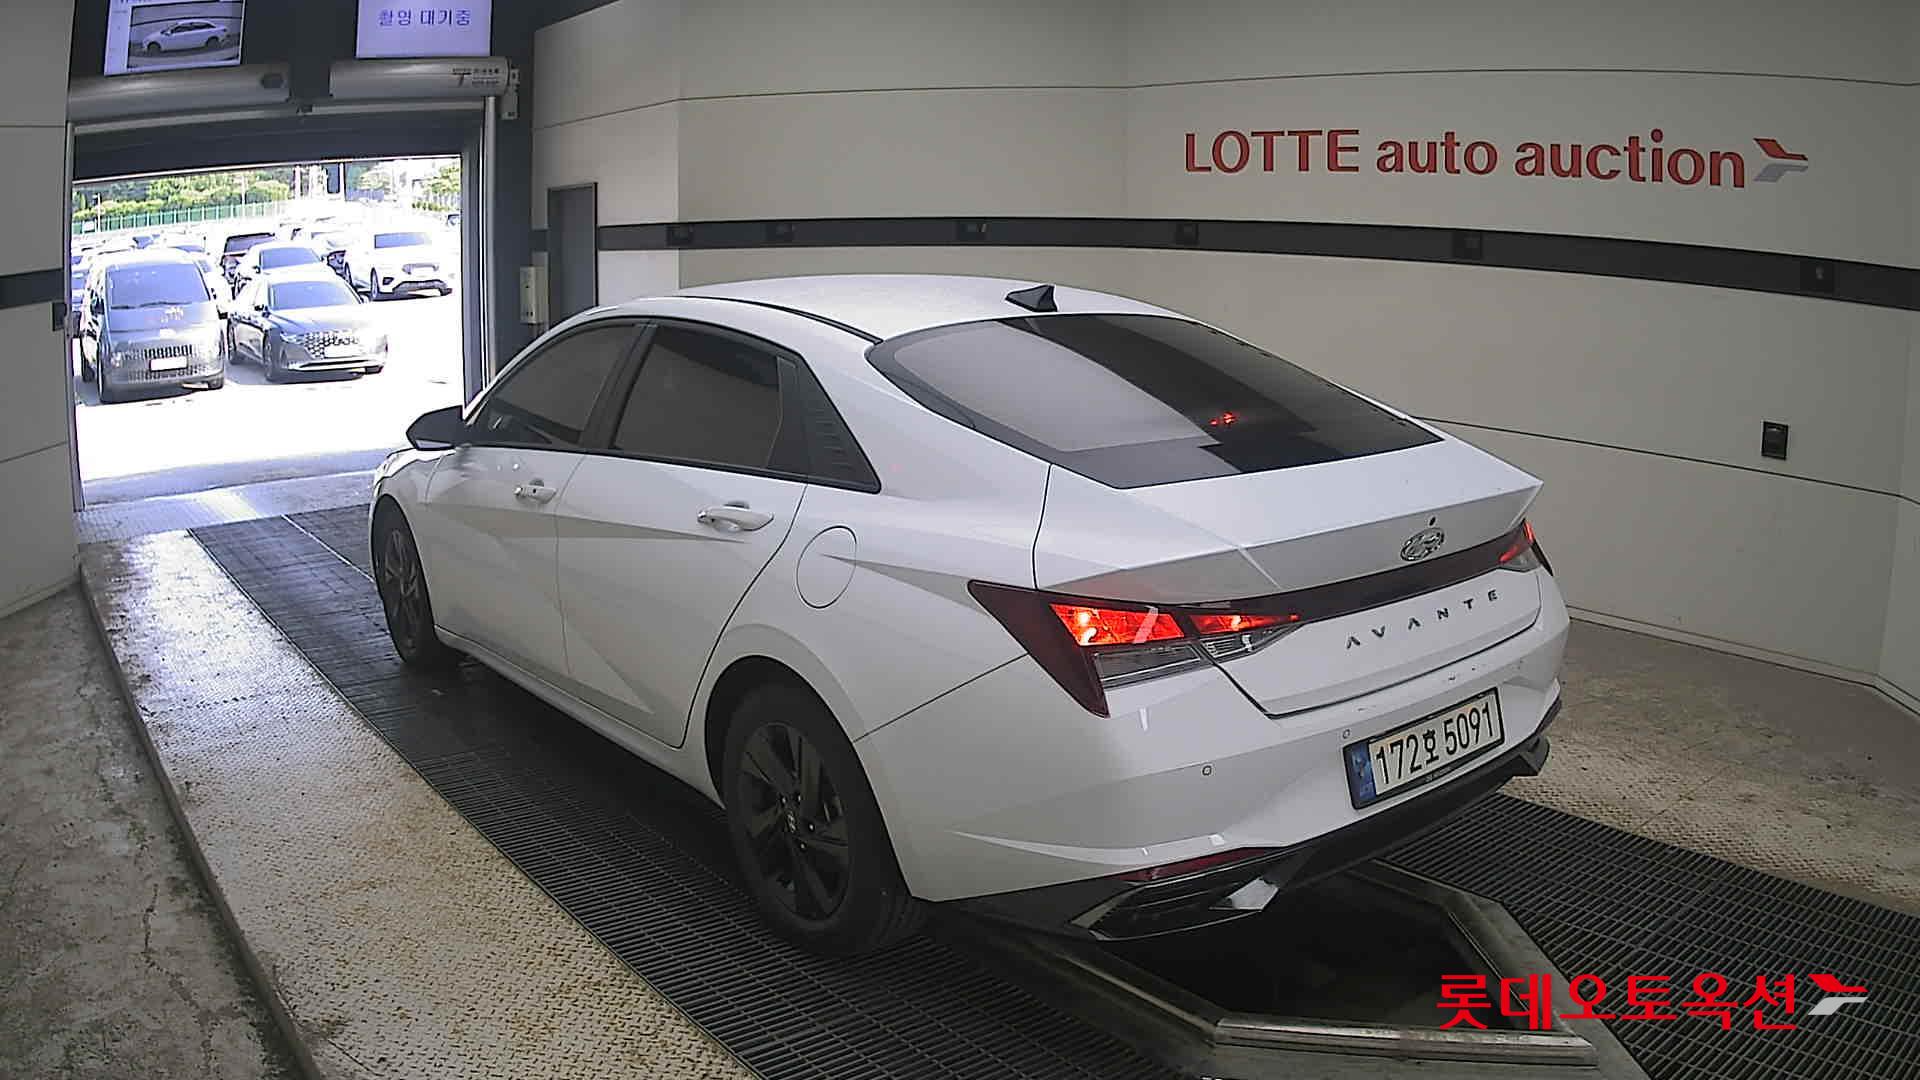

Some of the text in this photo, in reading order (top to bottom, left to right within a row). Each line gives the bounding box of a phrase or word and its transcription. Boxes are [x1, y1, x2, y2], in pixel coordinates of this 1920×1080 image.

[420, 8, 470, 27] 대기중
[1184, 128, 1746, 189] LOTTE auto auction
[1346, 589, 1499, 650] AVANTE
[1442, 701, 1494, 756] 5091
